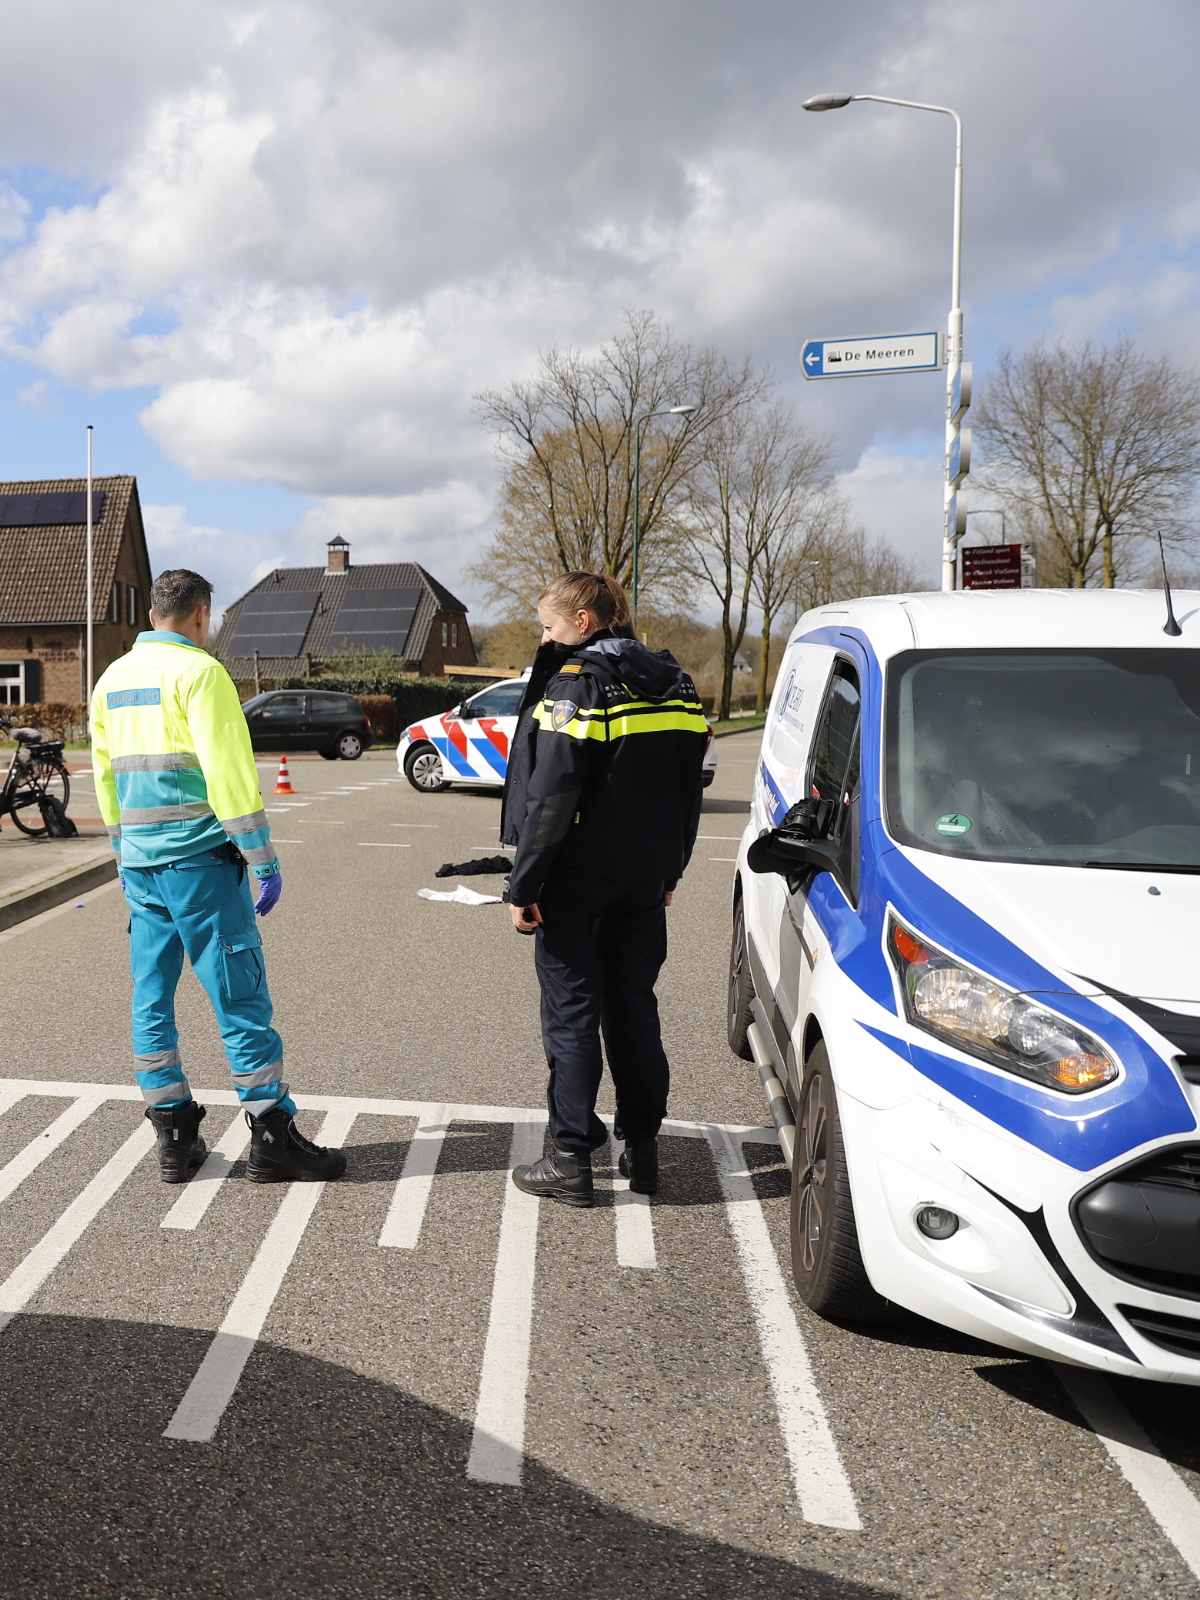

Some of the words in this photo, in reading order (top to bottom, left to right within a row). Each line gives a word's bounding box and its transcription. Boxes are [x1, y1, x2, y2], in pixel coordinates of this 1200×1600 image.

[845, 351, 861, 361] De
[866, 348, 914, 360] Meeren
[110, 691, 161, 706] AMBULANCE
[948, 814, 959, 826] 4
